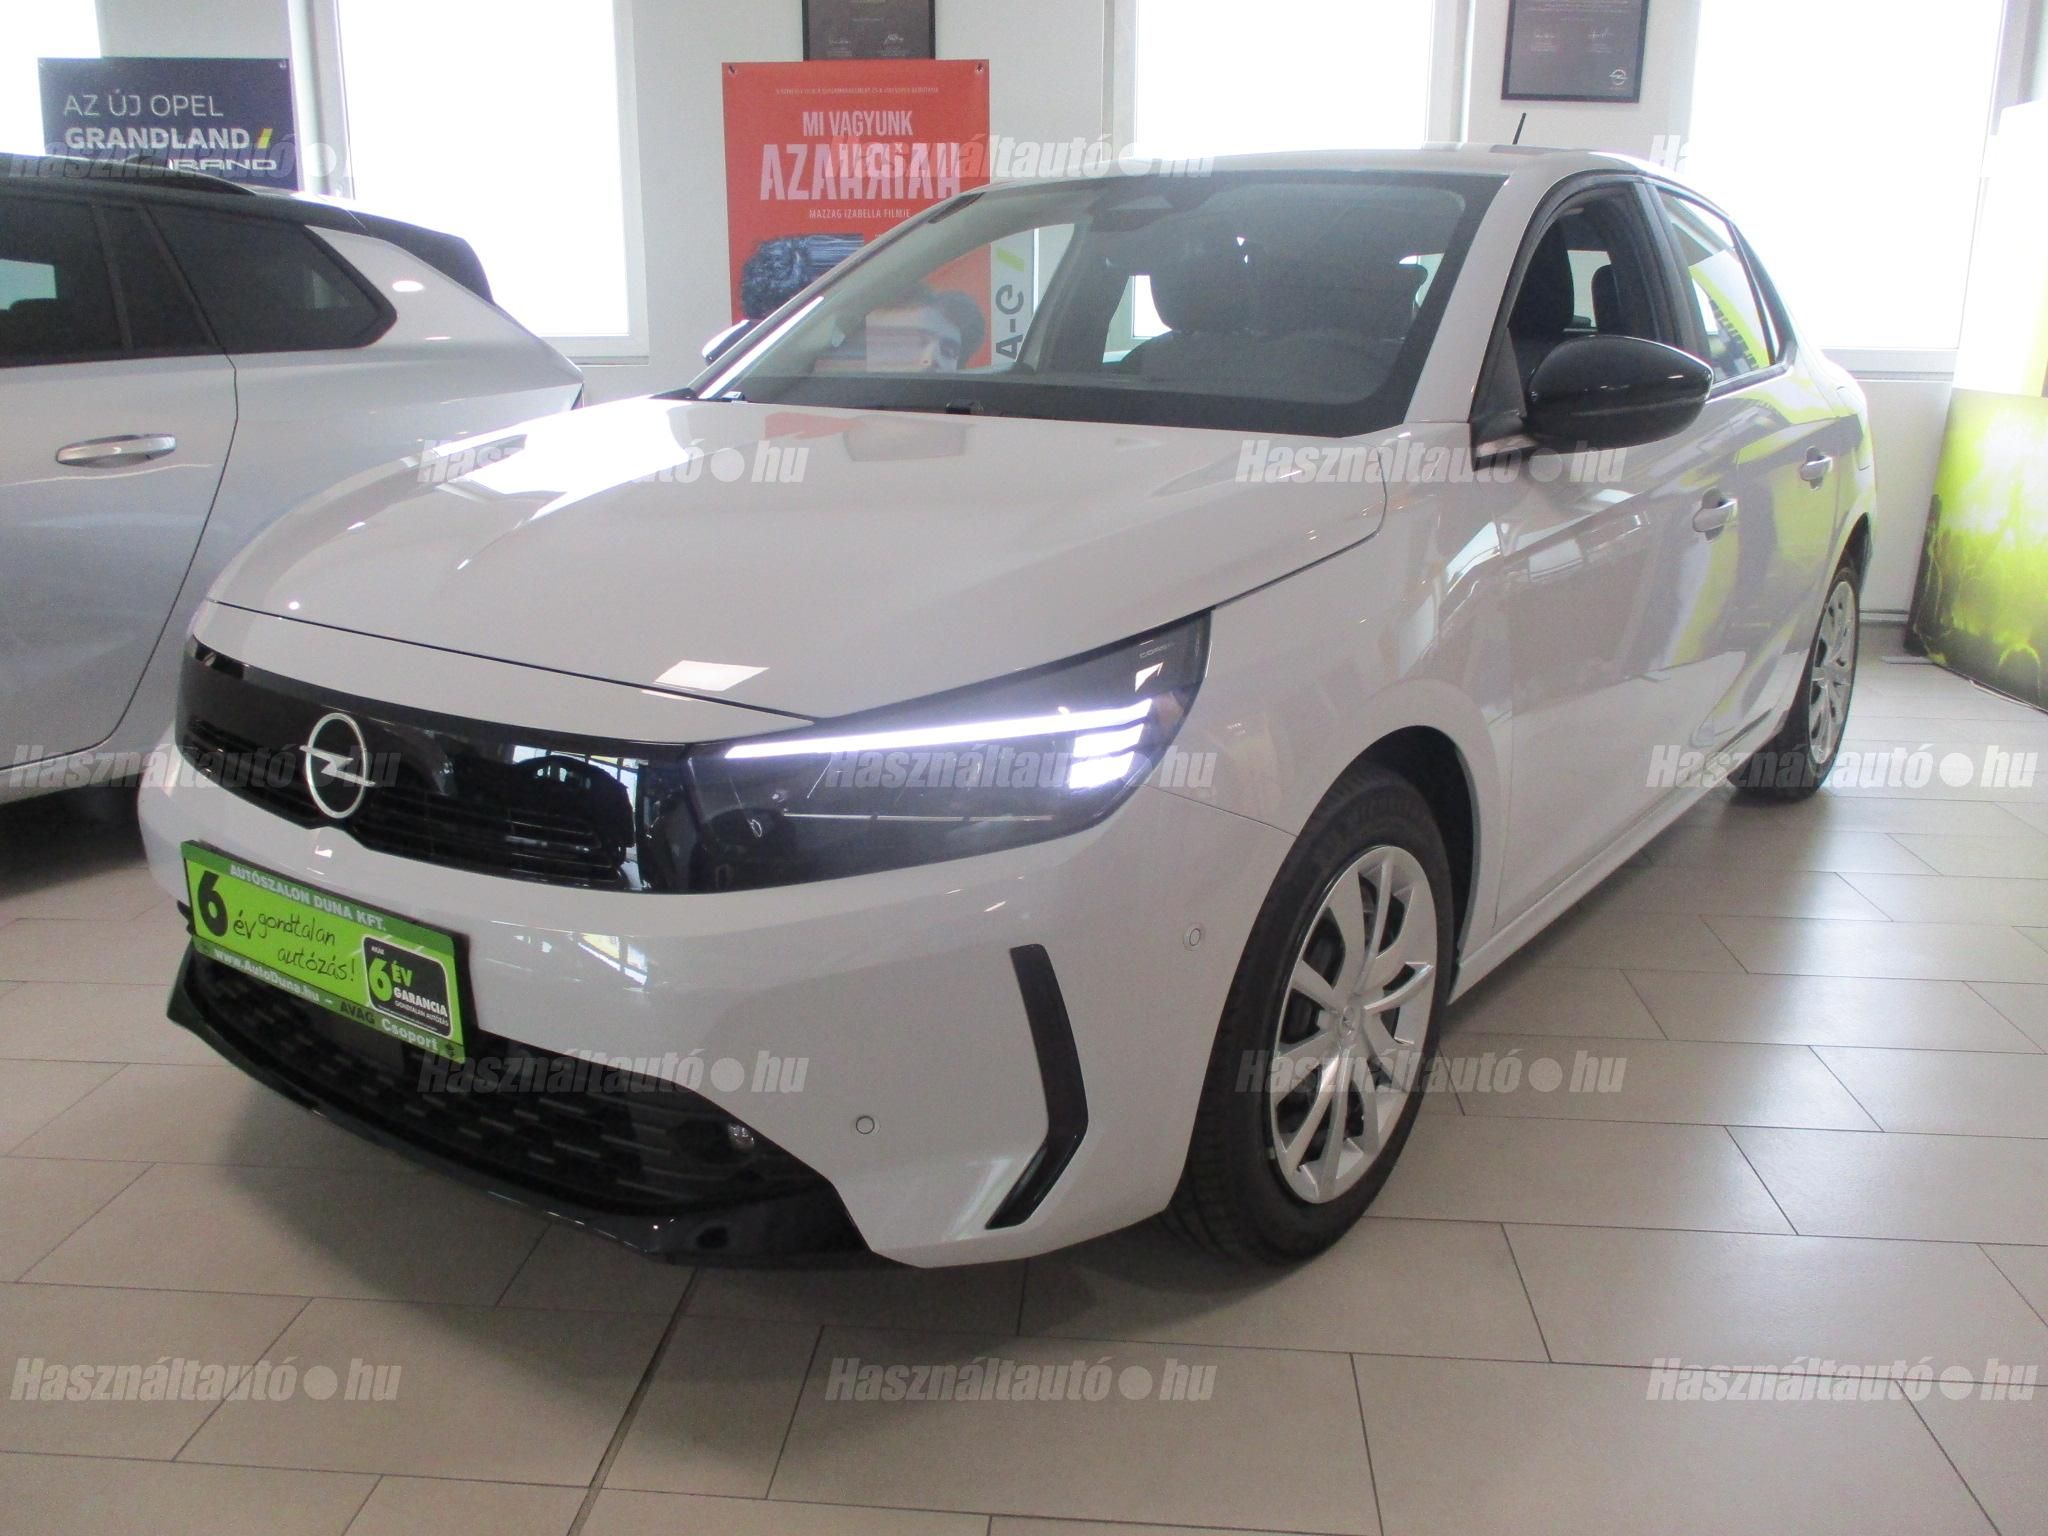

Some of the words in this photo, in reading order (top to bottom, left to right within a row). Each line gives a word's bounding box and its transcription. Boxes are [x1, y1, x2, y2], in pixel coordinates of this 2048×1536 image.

[63, 94, 100, 116] AZ
[108, 88, 141, 116] ÚJ
[150, 95, 224, 117] OPEL
[64, 126, 250, 150] GRANDLAND
[803, 111, 824, 136] MI
[829, 110, 913, 136] VAGYUNK
[167, 158, 277, 171] RAND
[844, 208, 881, 219] IZABELLA
[197, 870, 228, 937] 6
[233, 909, 256, 939] év
[258, 913, 336, 946] gondtalan
[230, 864, 310, 904] AUTÓSZALON
[314, 895, 353, 919] DUNA
[356, 910, 387, 931] KFT.
[278, 948, 356, 981] autózás!
[369, 958, 392, 1002] 6
[391, 960, 412, 987] ÉV
[394, 986, 448, 1018] GARANCIA
[340, 1002, 375, 1026] AVAG
[382, 1018, 438, 1051] Csoport
